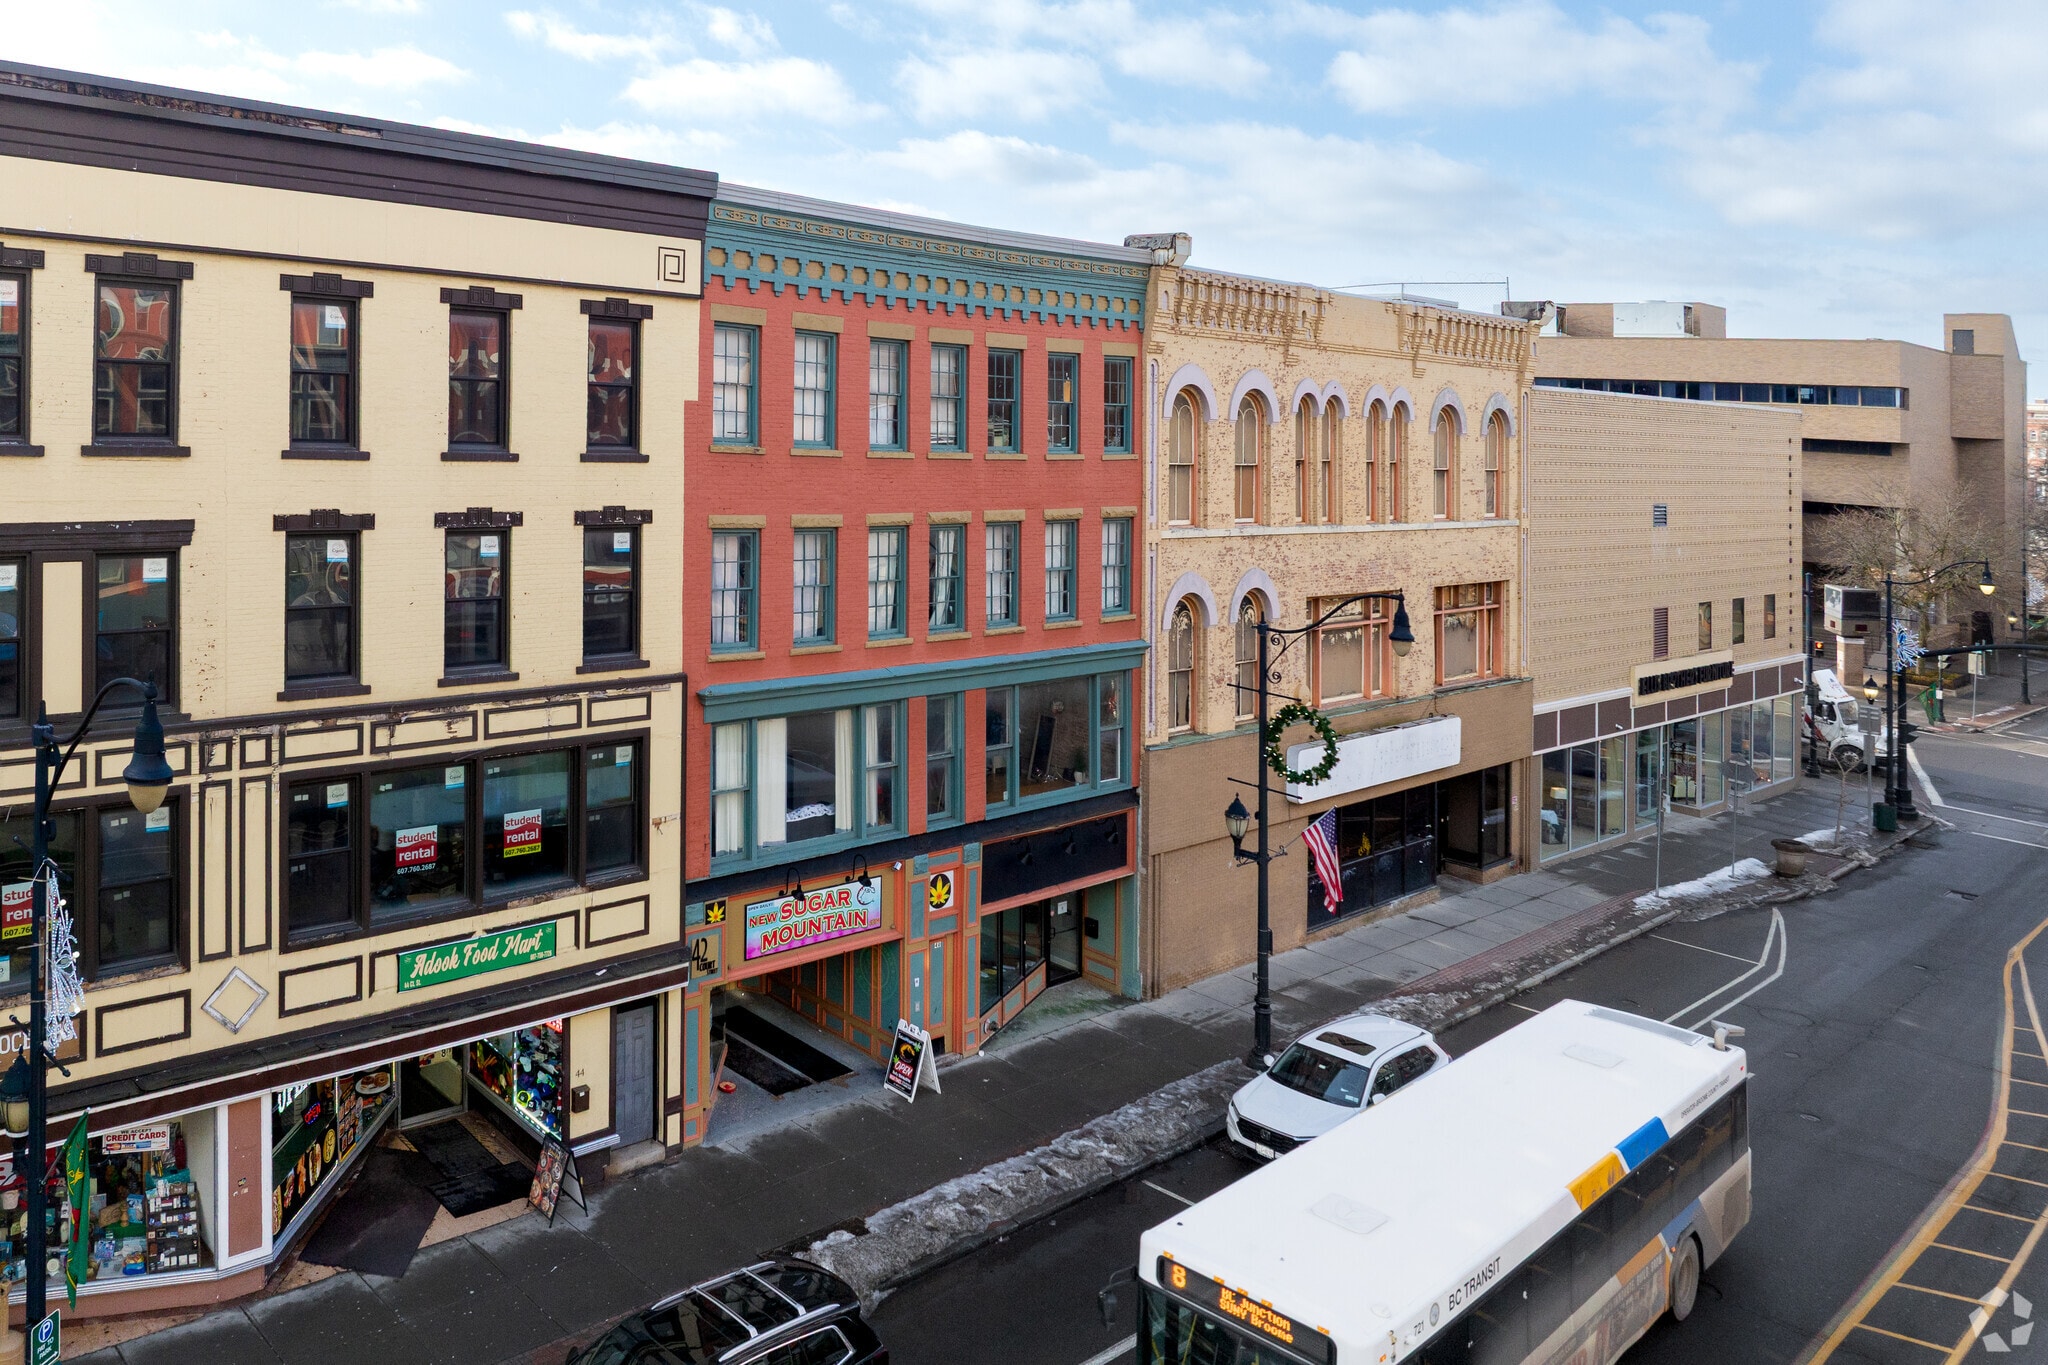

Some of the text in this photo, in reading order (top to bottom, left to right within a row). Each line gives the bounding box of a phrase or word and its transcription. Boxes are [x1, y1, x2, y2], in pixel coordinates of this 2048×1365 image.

[505, 814, 541, 827] student
[398, 831, 436, 844] student
[506, 828, 539, 843] rental
[399, 845, 434, 862] rental
[397, 863, 436, 874] 607.760.2687
[4, 886, 33, 902] stud
[6, 908, 33, 922] ren
[749, 889, 851, 928] NEW SUGAR
[762, 910, 868, 952] MOUNTAIN
[410, 928, 544, 978] Adook Food Mart
[692, 938, 708, 971] 42
[575, 1069, 585, 1078] 44
[895, 1061, 913, 1075] OPEN
[106, 1131, 167, 1142] CREDIT CARDS
[1172, 1264, 1187, 1289] 8
[1449, 1256, 1501, 1311] BC TRANSIT
[1221, 1288, 1291, 1331] BC Junction
[1219, 1299, 1294, 1344] SUNY Broome
[1413, 1320, 1424, 1336] 721
